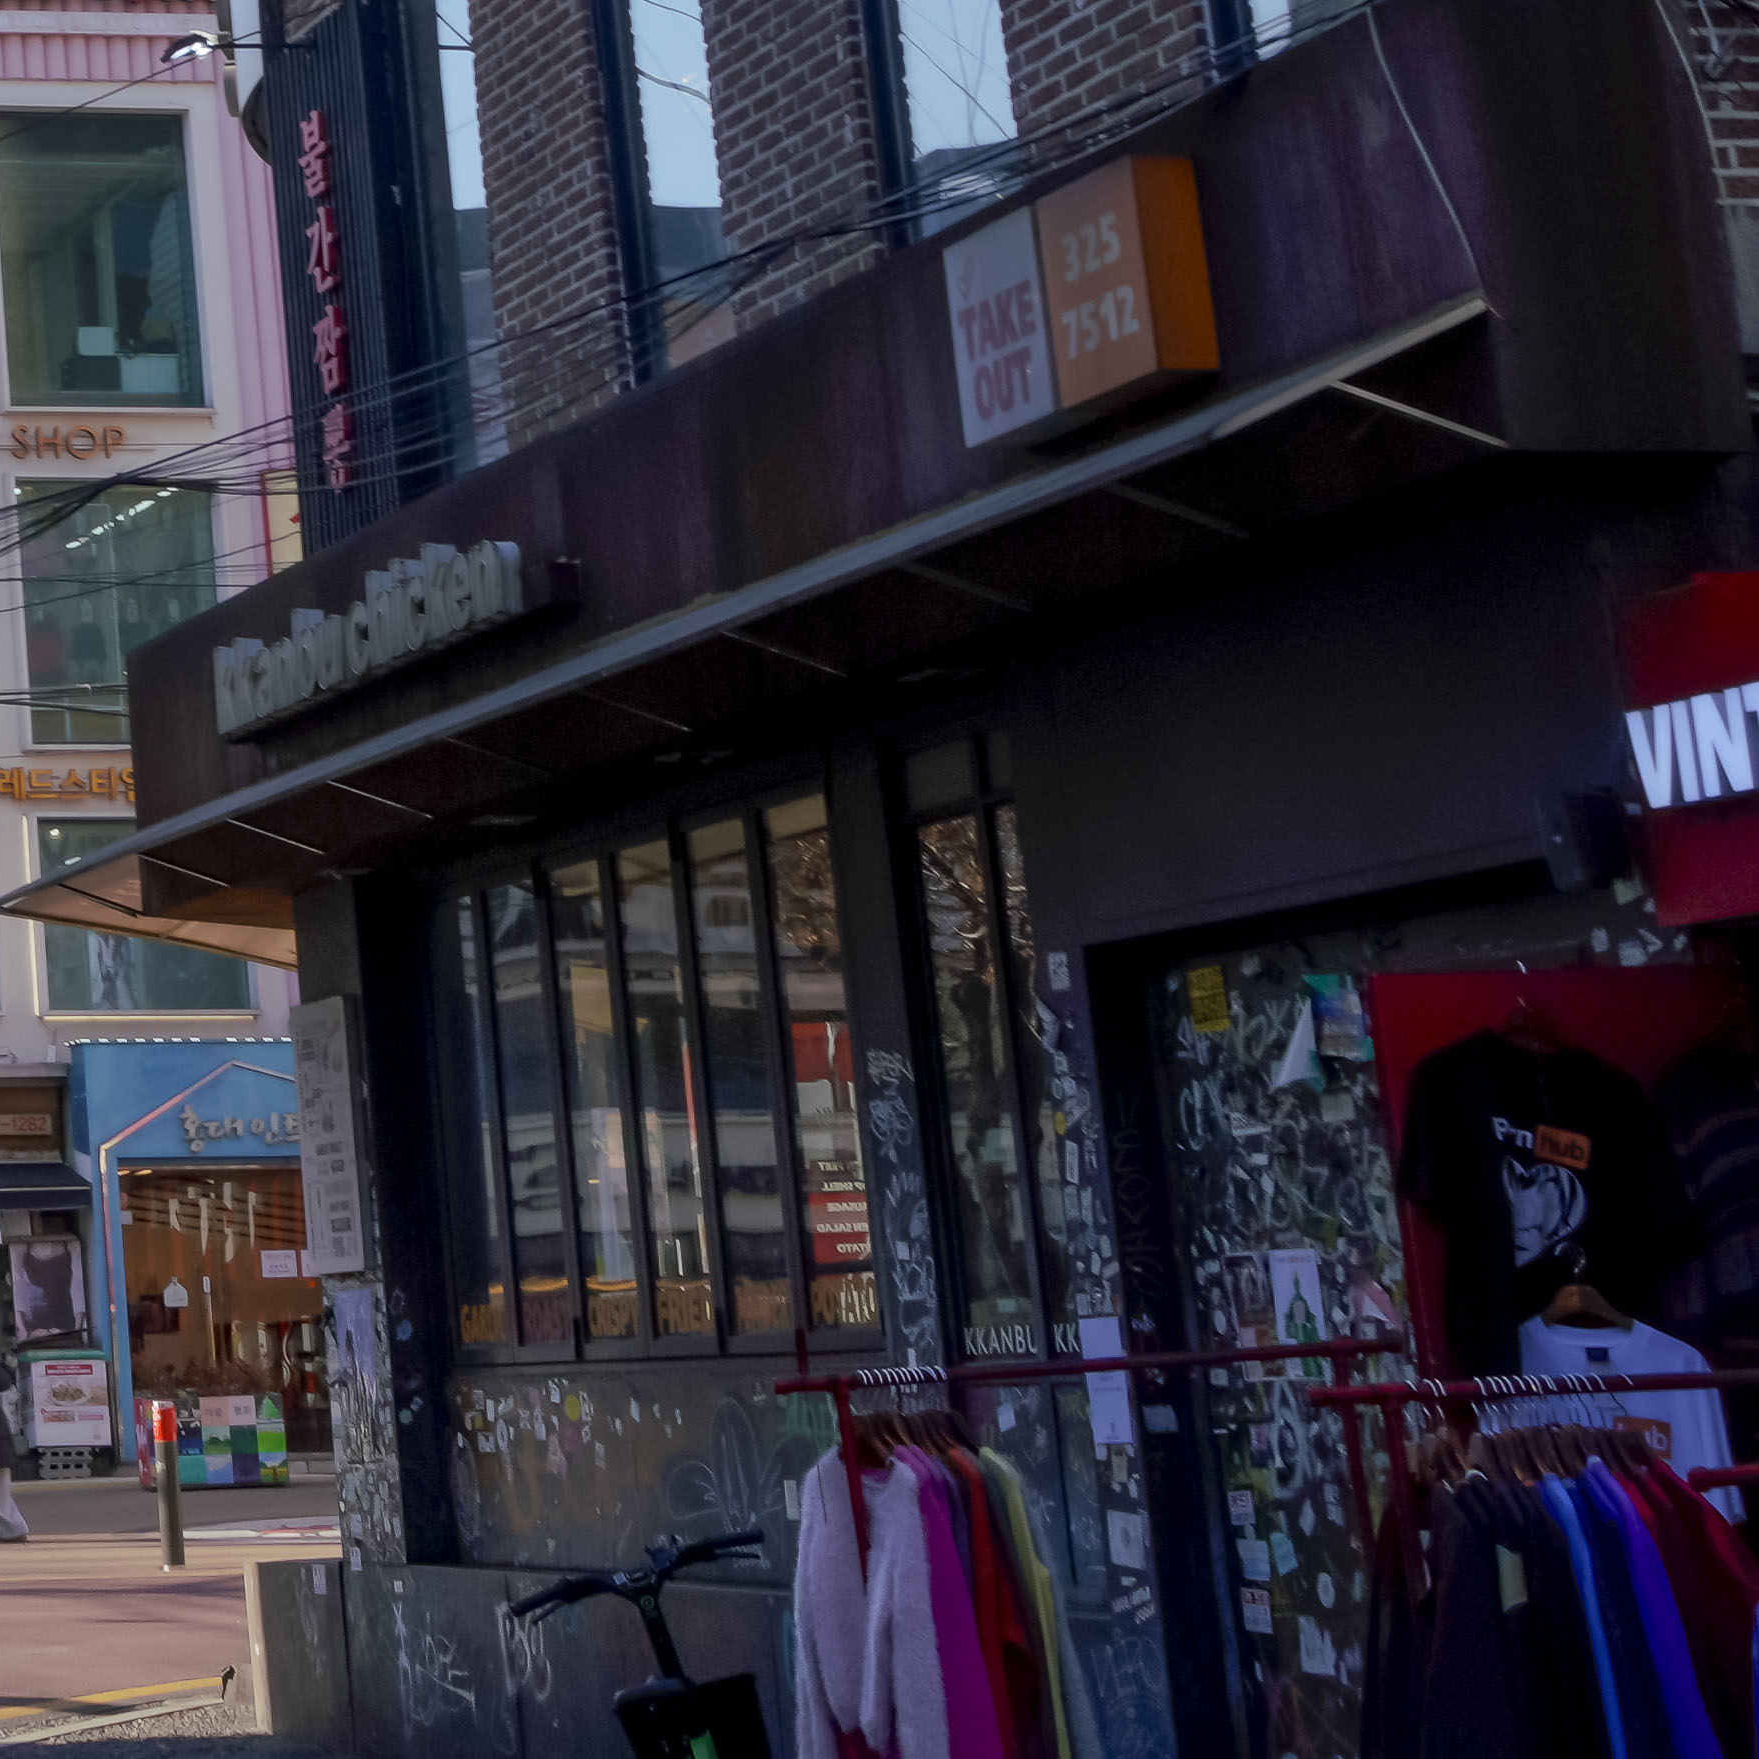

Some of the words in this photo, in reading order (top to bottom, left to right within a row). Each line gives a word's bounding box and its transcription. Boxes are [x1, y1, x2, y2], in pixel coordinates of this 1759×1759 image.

[1063, 211, 1122, 284] 325
[958, 278, 1038, 355] TAKE
[1060, 284, 1140, 362] 7512
[973, 350, 1033, 419] OUT
[11, 425, 126, 461] SHOP
